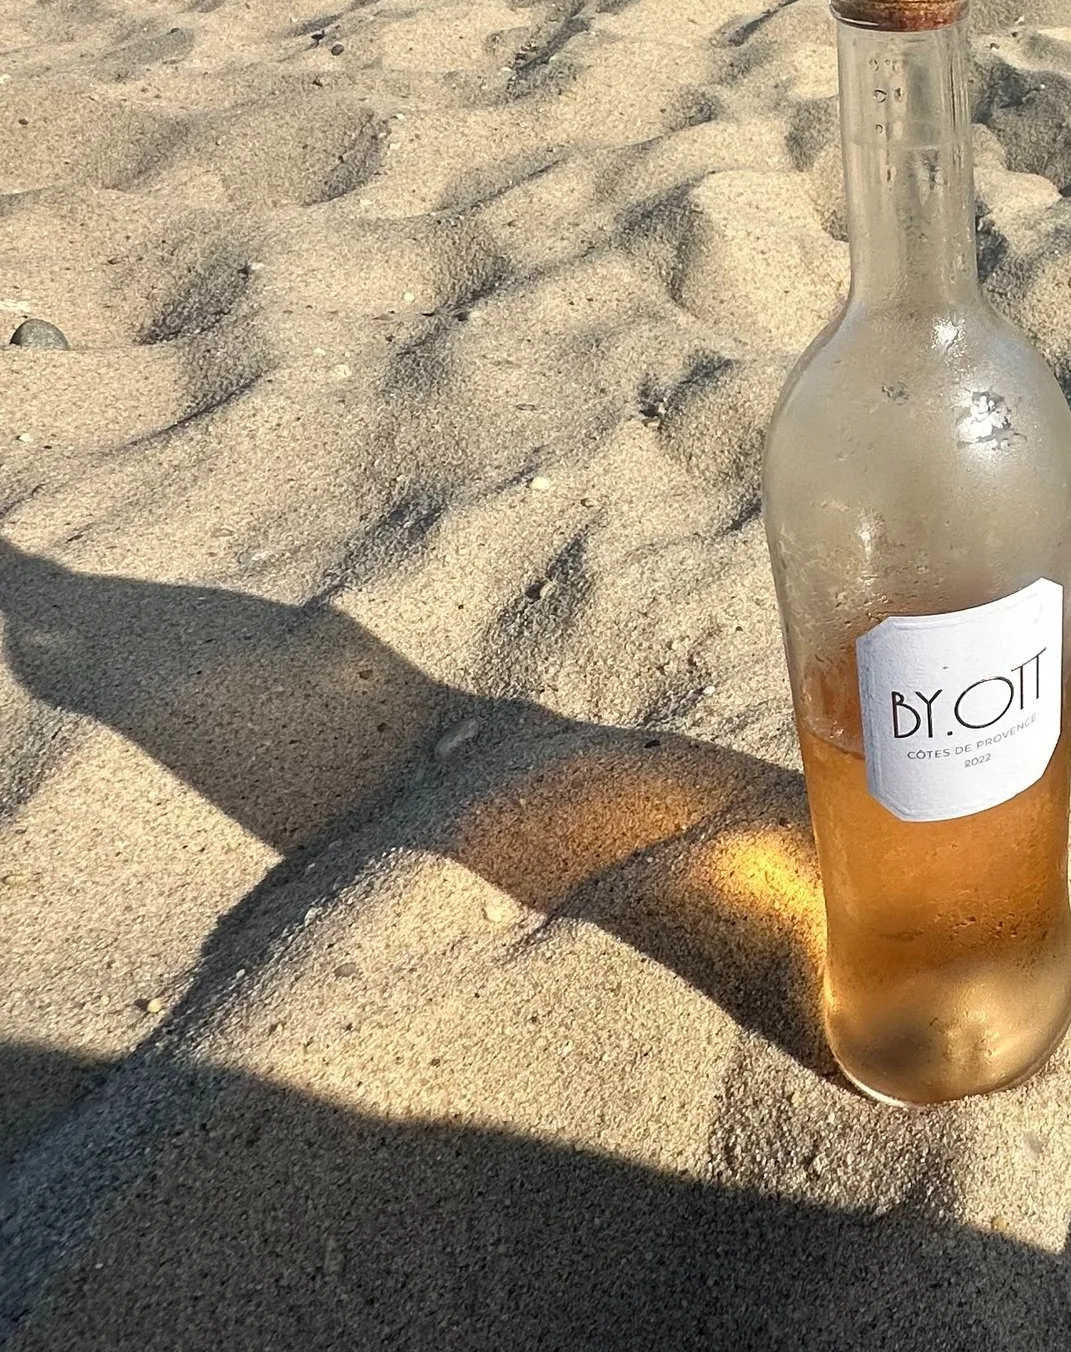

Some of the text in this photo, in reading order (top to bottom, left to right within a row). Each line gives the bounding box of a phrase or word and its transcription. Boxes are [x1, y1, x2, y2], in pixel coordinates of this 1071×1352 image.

[907, 713, 1037, 760] CÔTES DE PROVENCE
[964, 753, 992, 768] 2022
